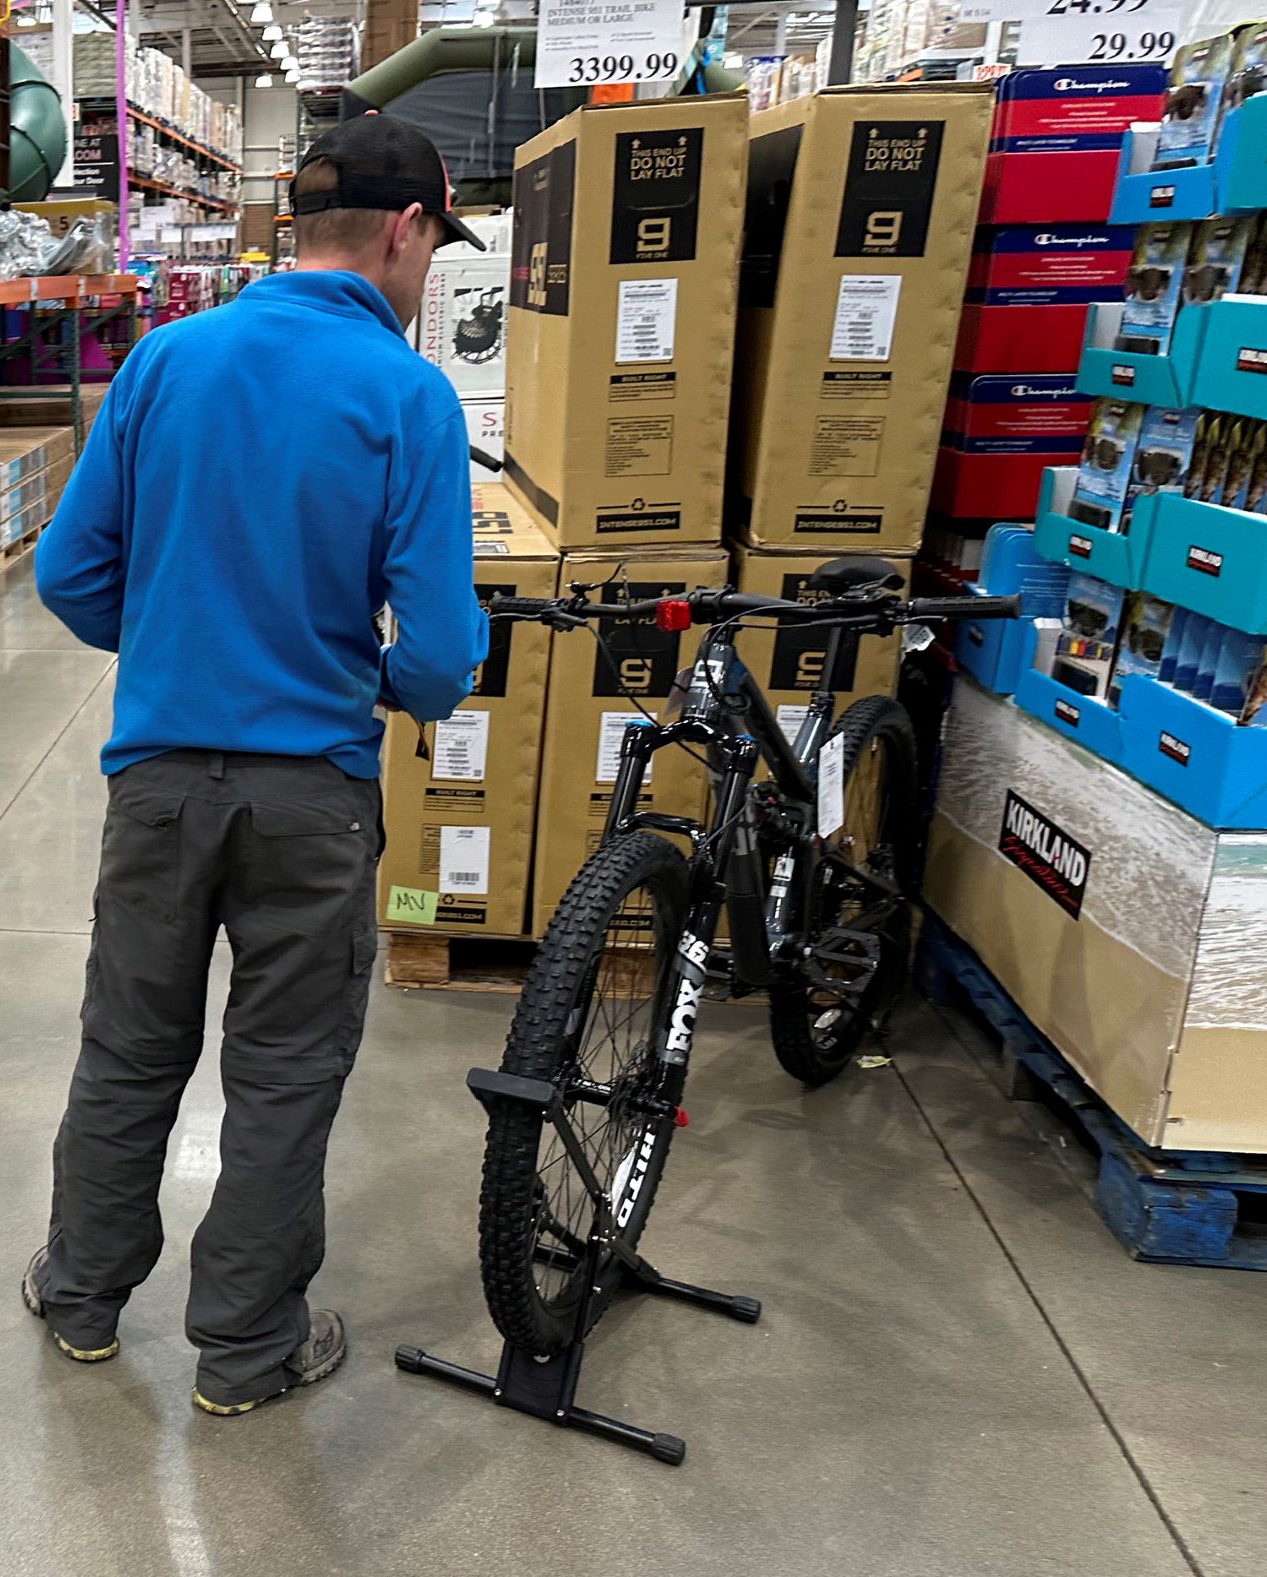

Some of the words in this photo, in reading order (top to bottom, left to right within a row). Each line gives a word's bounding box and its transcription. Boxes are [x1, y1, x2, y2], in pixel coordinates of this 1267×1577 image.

[547, 6, 586, 17] INTENSE
[605, 5, 631, 14] TRAIL
[634, 3, 655, 12] BIKE
[547, 15, 586, 26] MEDIUM
[588, 15, 601, 24] OR
[603, 13, 634, 23] LARGE
[1090, 31, 1175, 60] 29.99
[569, 52, 678, 83] 3399.99
[1053, 78, 1131, 93] Champion
[867, 140, 889, 148] THIS
[890, 140, 911, 148] END
[912, 139, 928, 147] UP
[632, 148, 653, 157] THIS
[654, 147, 672, 156] END
[673, 147, 688, 155] UP
[866, 148, 890, 160] DO
[892, 147, 925, 159] NOT
[631, 157, 652, 170] DO
[655, 155, 687, 168] NOT
[865, 160, 887, 171] LAY
[890, 160, 923, 171] FLAT
[631, 169, 653, 181] LAY
[655, 168, 685, 179] FLAT
[1034, 233, 1110, 248] Champion
[426, 273, 440, 366] ONDORS
[482, 412, 497, 427] S
[1006, 799, 1086, 886] KIRKLAND
[436, 910, 482, 921] SE951.COM
[678, 929, 710, 966] 36
[666, 978, 704, 1051] FOX
